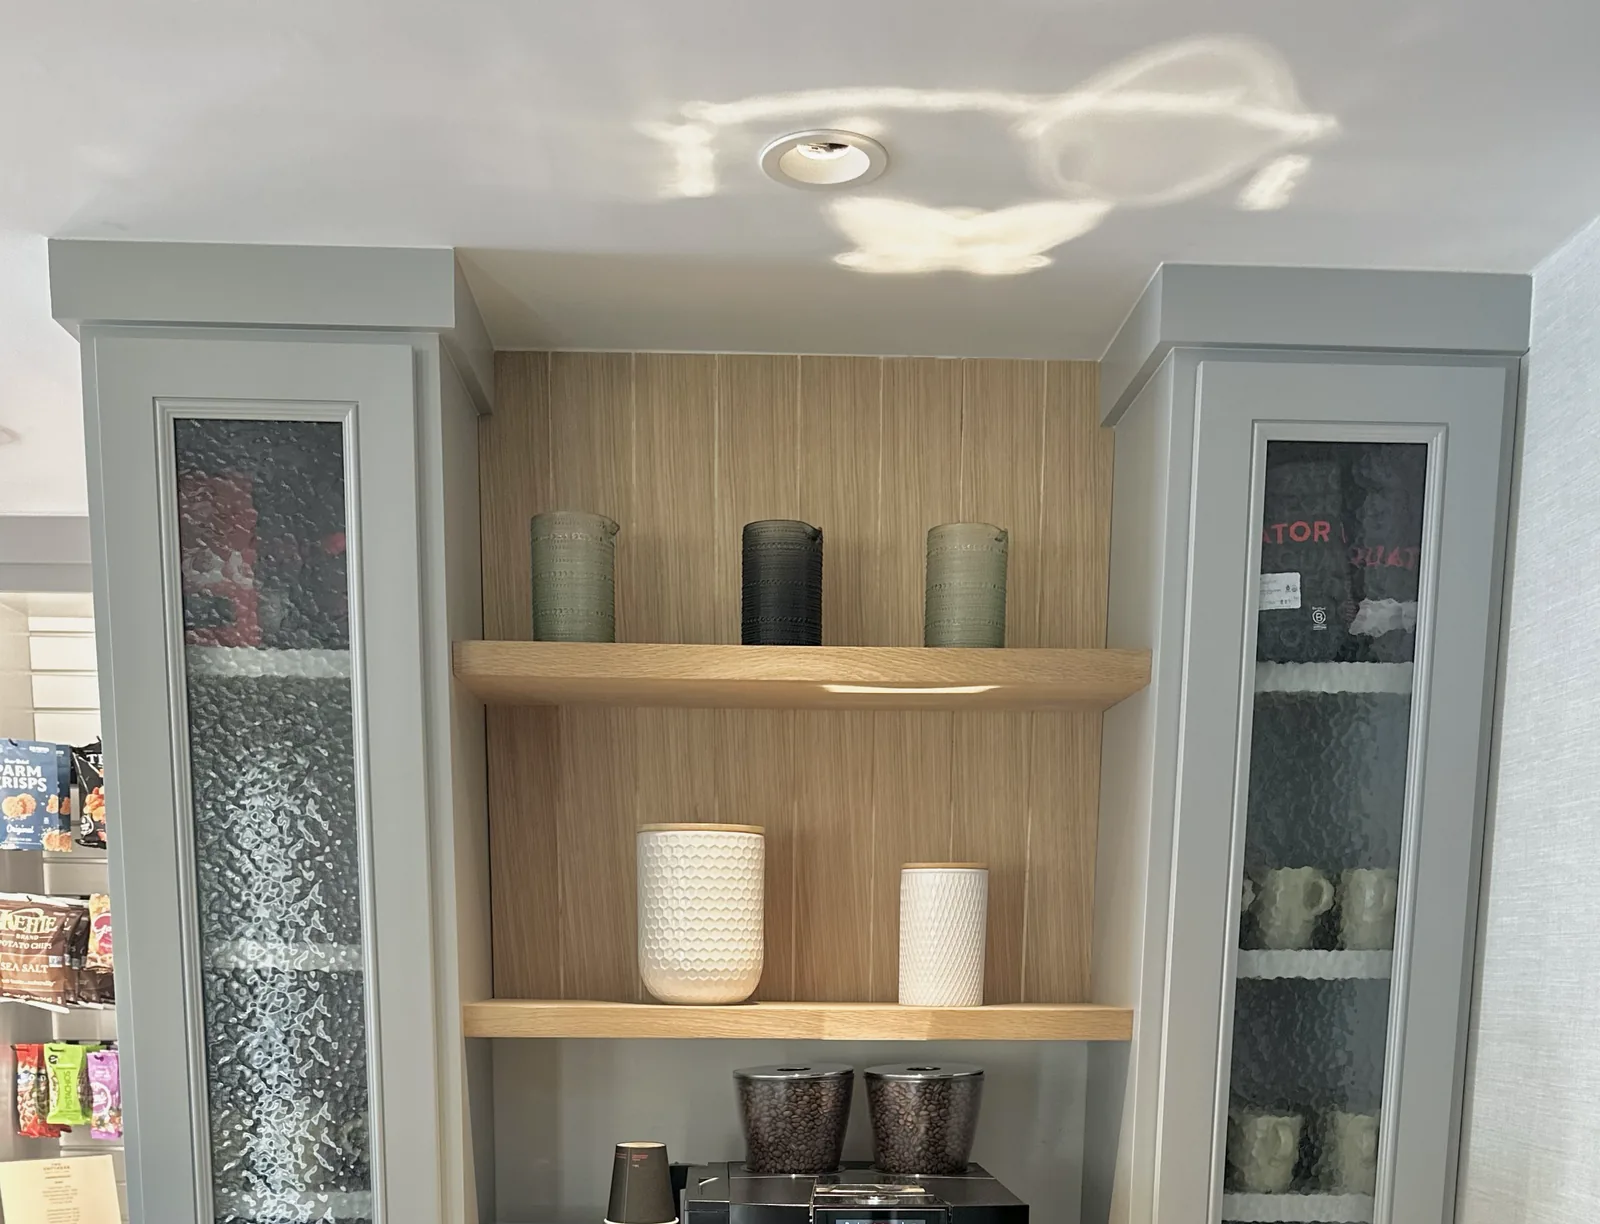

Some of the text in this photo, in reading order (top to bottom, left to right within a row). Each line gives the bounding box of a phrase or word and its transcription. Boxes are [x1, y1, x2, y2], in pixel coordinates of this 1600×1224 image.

[0, 776, 48, 793] RISPS
[0, 940, 52, 950] OTATO CHIPS
[0, 962, 49, 974] SEA SALT
